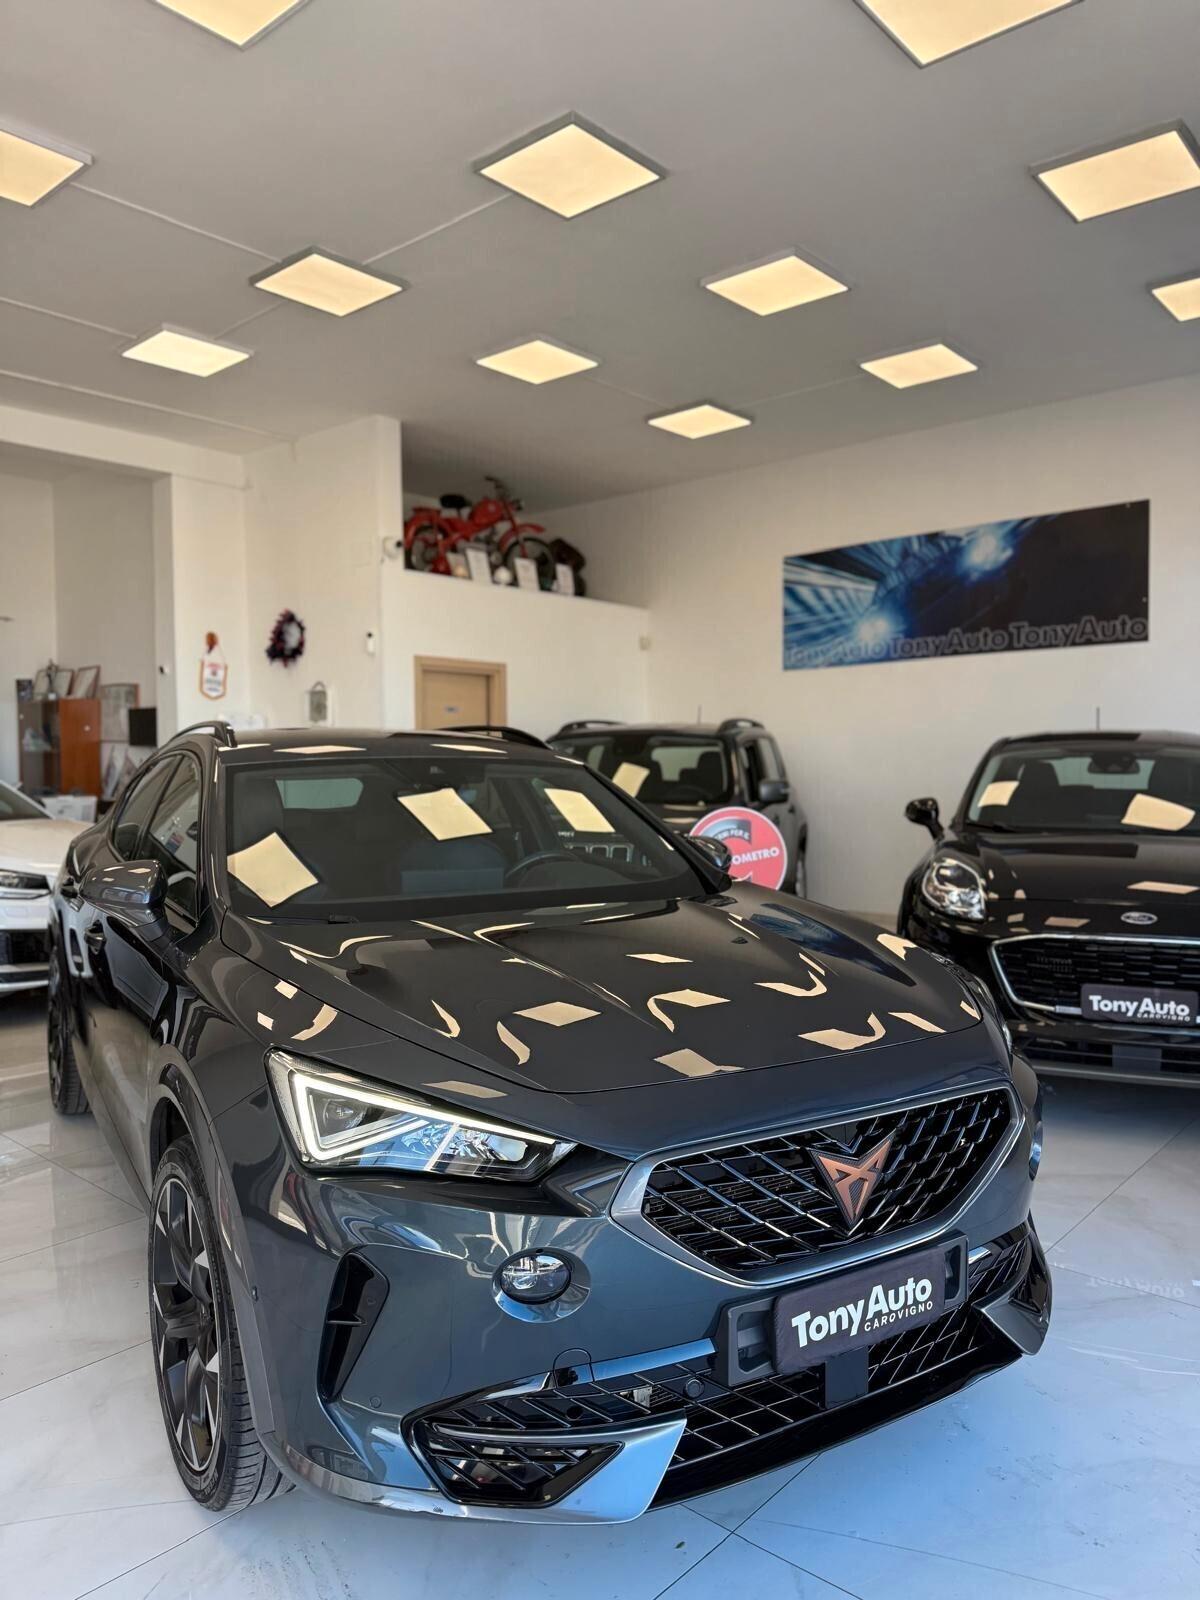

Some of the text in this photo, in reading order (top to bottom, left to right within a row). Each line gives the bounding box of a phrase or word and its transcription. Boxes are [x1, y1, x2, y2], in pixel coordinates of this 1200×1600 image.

[890, 625, 1009, 657] TonyAuto
[1009, 614, 1148, 648] TonyAuto
[731, 847, 780, 865] OMETRO
[1089, 995, 1190, 1017] TonyAuto
[1137, 1013, 1191, 1023] CAROVIGNO
[791, 1277, 932, 1347] TonyAuto
[864, 1301, 934, 1332] CAROVIGNO
